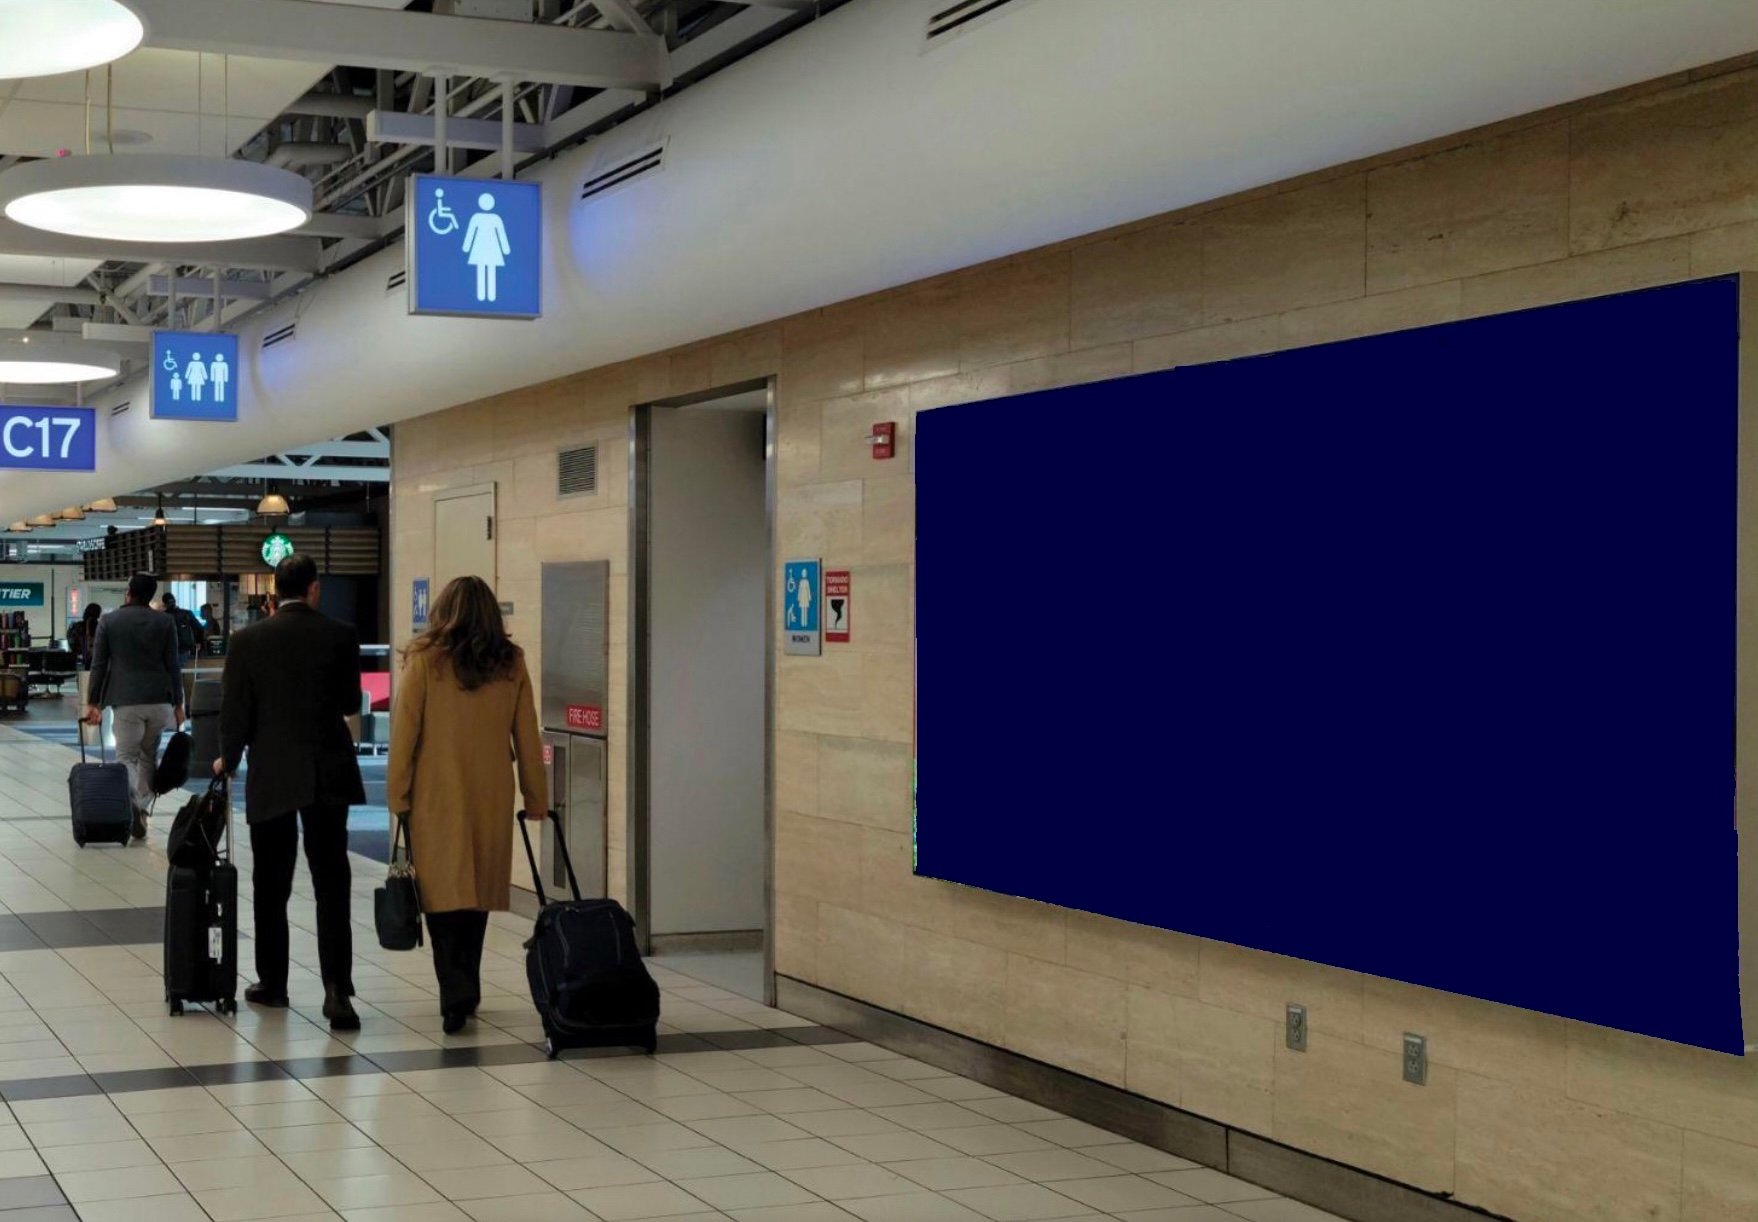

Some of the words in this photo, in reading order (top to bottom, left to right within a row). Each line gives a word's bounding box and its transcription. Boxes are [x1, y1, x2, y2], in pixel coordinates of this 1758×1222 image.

[3, 415, 81, 458] C17
[0, 588, 31, 600] TIER
[568, 708, 582, 724] FIRE
[582, 709, 600, 727] HOSE
